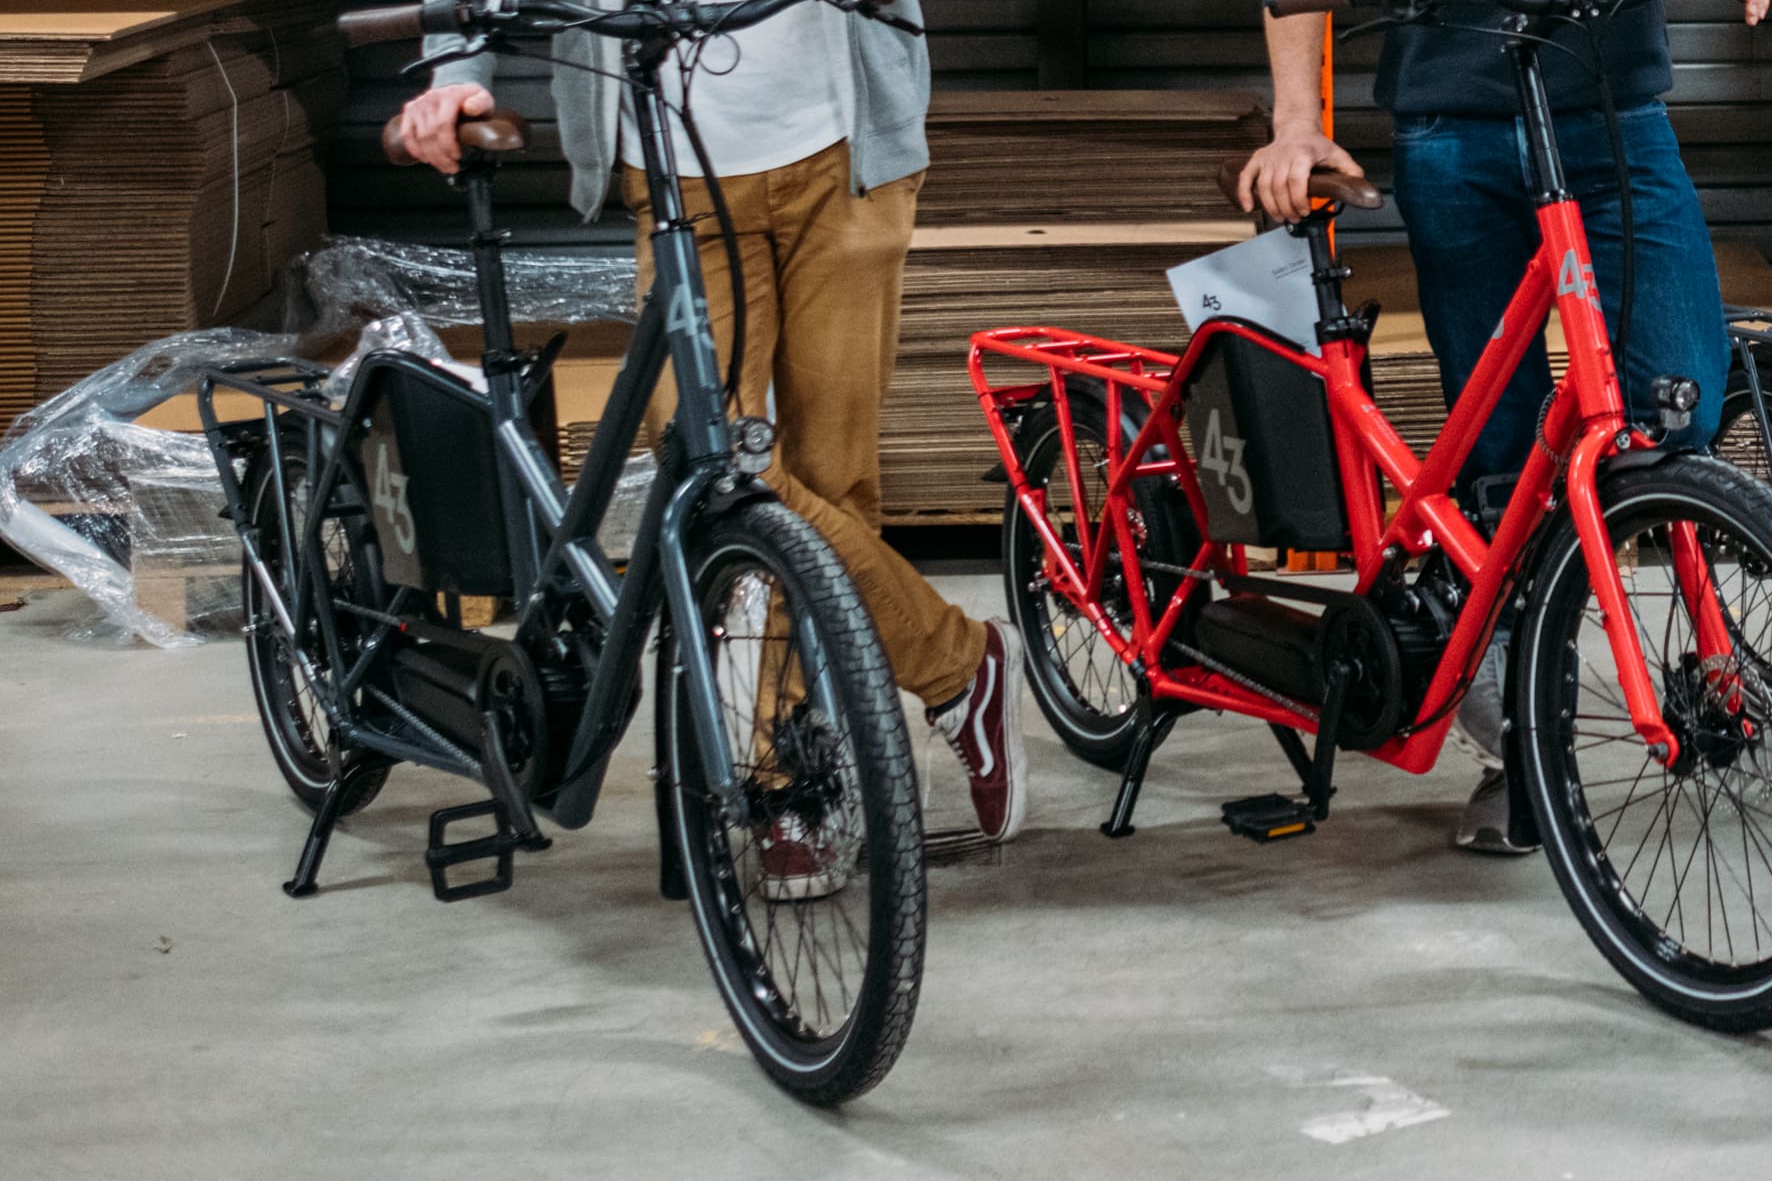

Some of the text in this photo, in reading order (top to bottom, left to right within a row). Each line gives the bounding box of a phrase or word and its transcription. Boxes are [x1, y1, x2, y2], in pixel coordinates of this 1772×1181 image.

[1202, 293, 1222, 310] 43
[375, 443, 416, 555] 43
[1200, 409, 1252, 515] 43
